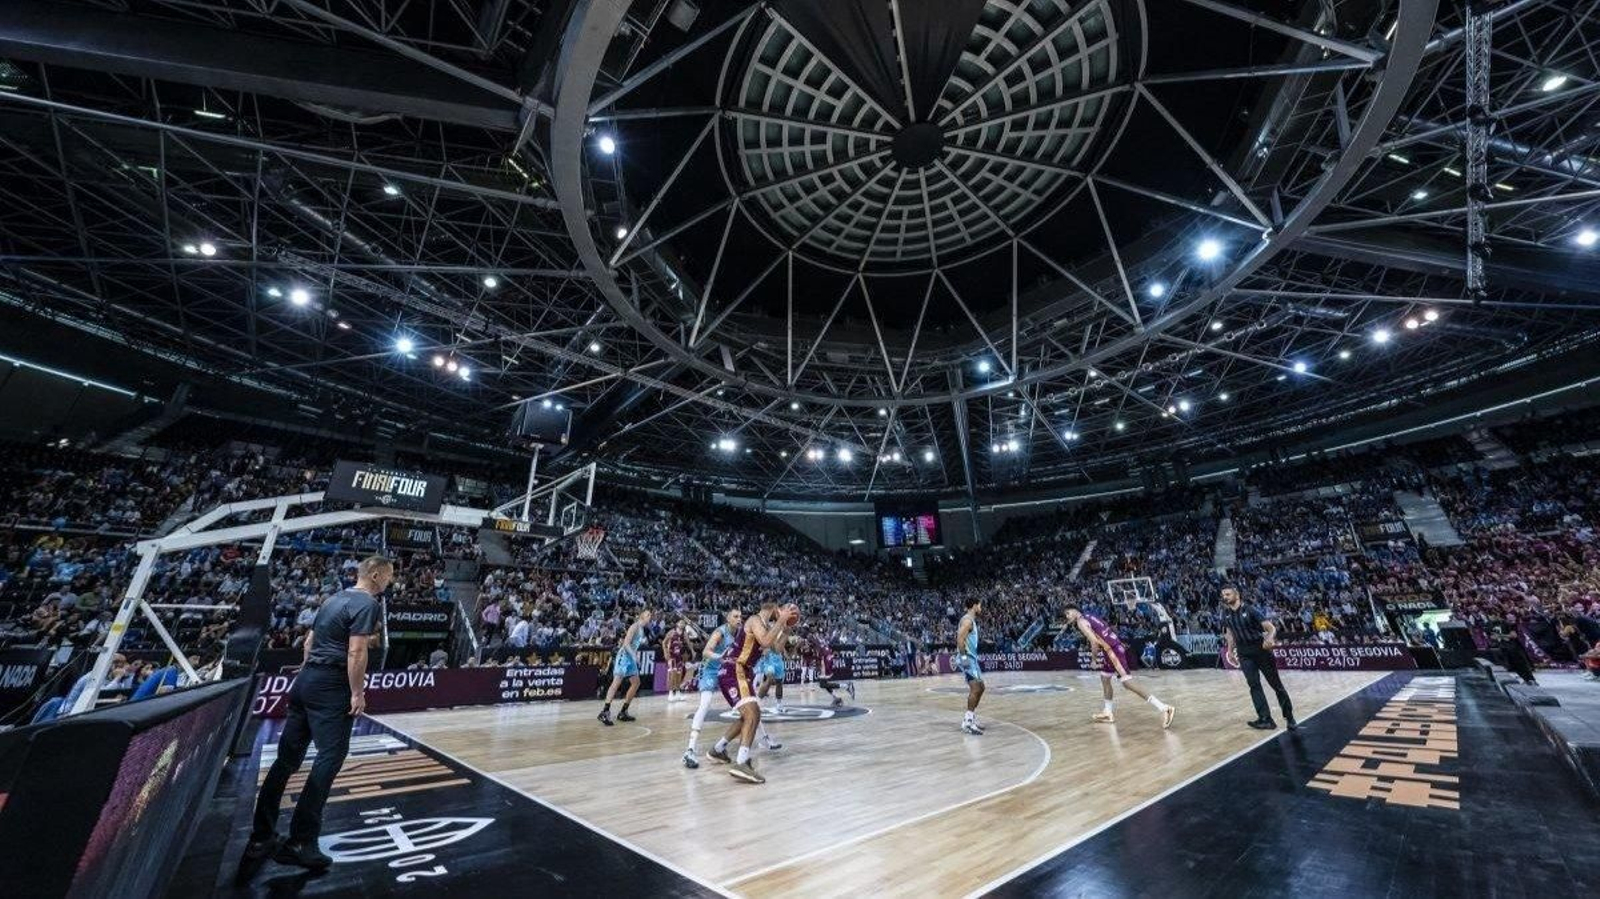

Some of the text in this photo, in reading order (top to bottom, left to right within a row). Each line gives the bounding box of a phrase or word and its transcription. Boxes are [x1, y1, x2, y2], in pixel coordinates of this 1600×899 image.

[387, 611, 448, 621] MADRID
[1288, 648, 1330, 657] CIUDAD
[1331, 647, 1347, 657] DE
[1349, 646, 1403, 656] SEGOVIA
[1286, 657, 1316, 667] 22/07
[1327, 656, 1361, 667] 24/07
[506, 667, 565, 677] Entradas
[500, 677, 563, 688] a la venta
[502, 687, 562, 698] en feb.es
